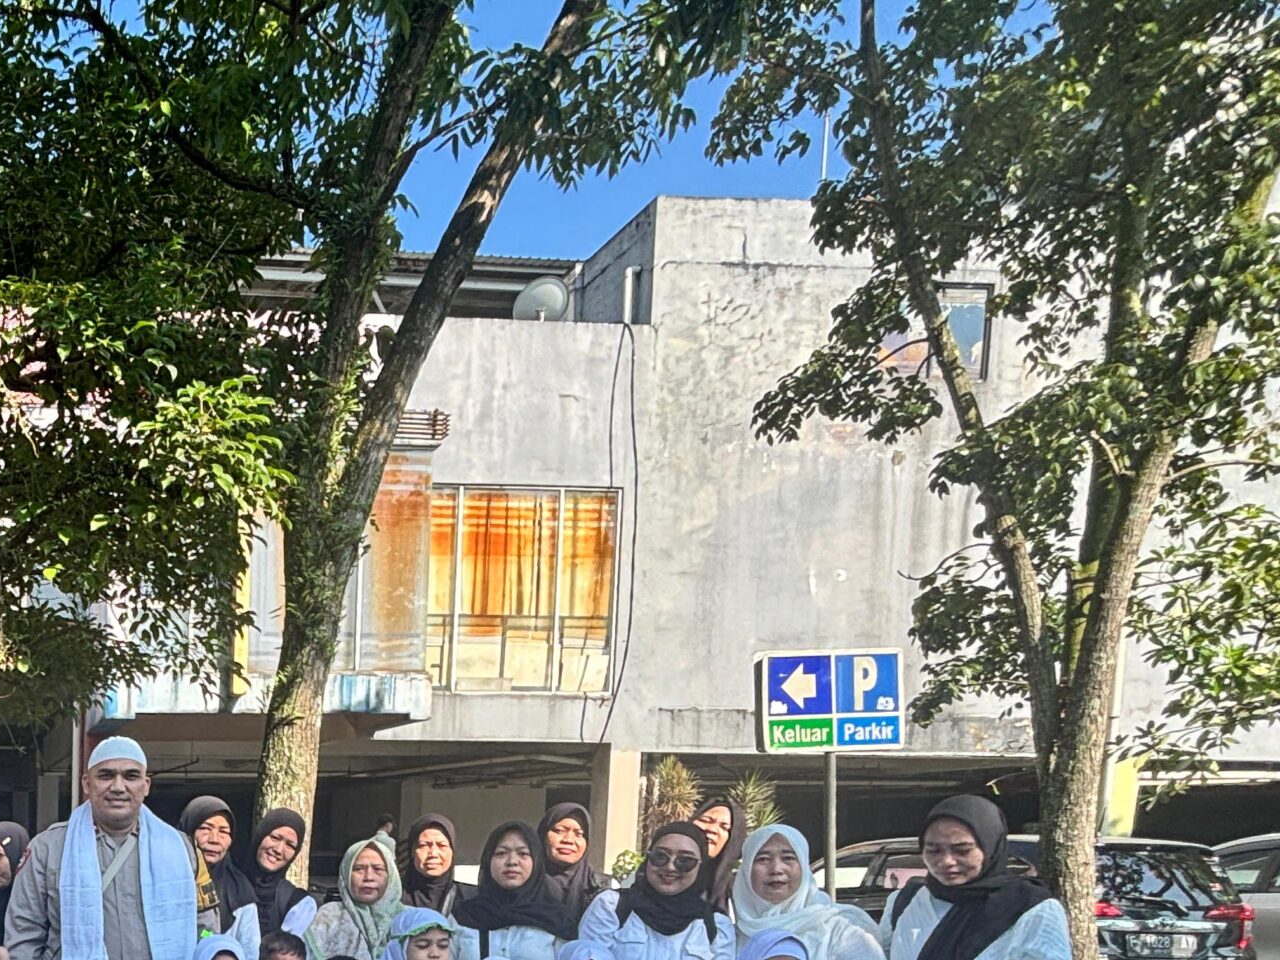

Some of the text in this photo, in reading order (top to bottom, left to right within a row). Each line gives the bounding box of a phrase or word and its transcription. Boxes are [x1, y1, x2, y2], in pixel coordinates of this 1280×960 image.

[853, 656, 878, 711] P
[773, 724, 830, 743] Keluar
[844, 721, 895, 742] Parkir
